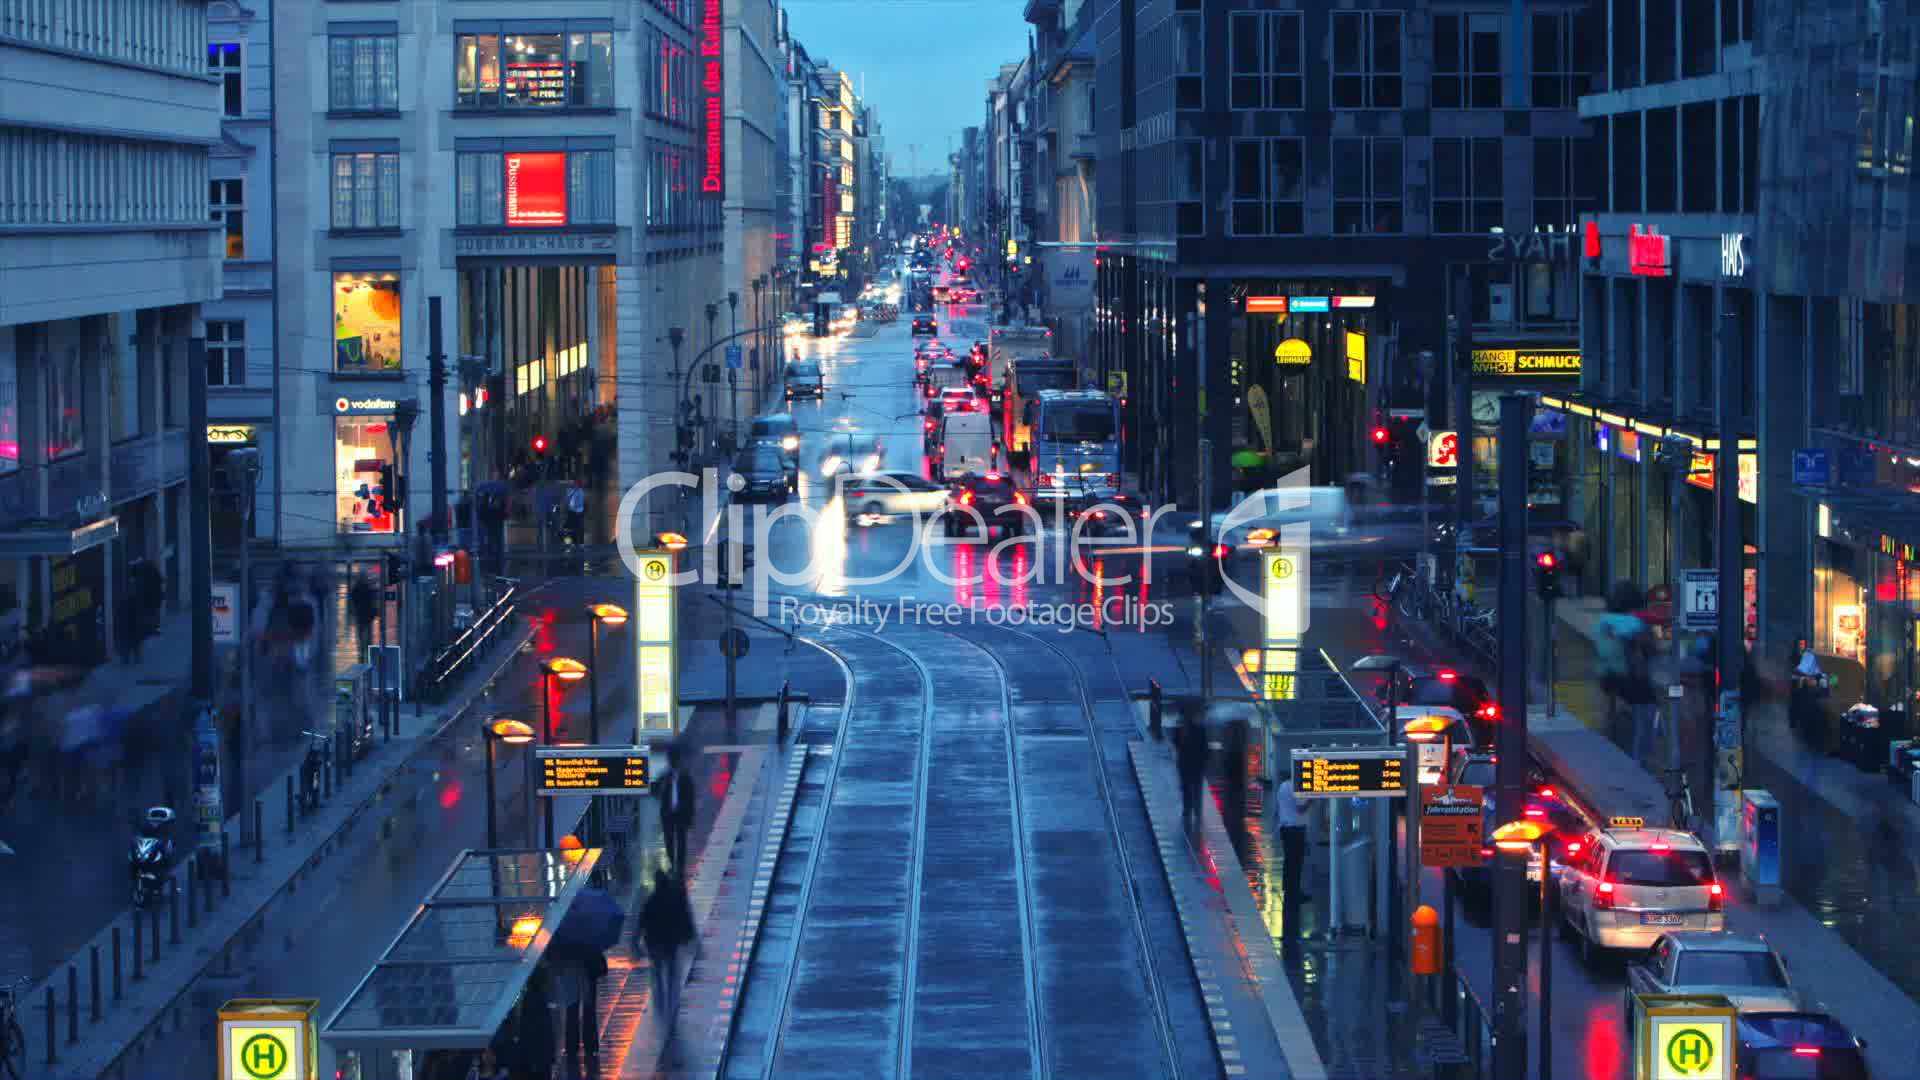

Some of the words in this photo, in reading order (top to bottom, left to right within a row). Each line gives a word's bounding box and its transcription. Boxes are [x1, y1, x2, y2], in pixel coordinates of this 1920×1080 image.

[704, 61, 720, 93] das
[703, 97, 720, 192] Dussmann
[508, 158, 520, 218] Dussmann
[1721, 233, 1744, 277] HAYS
[1519, 356, 1581, 368] SCHMUCK
[253, 1044, 275, 1069] H
[1679, 1039, 1701, 1065] H
